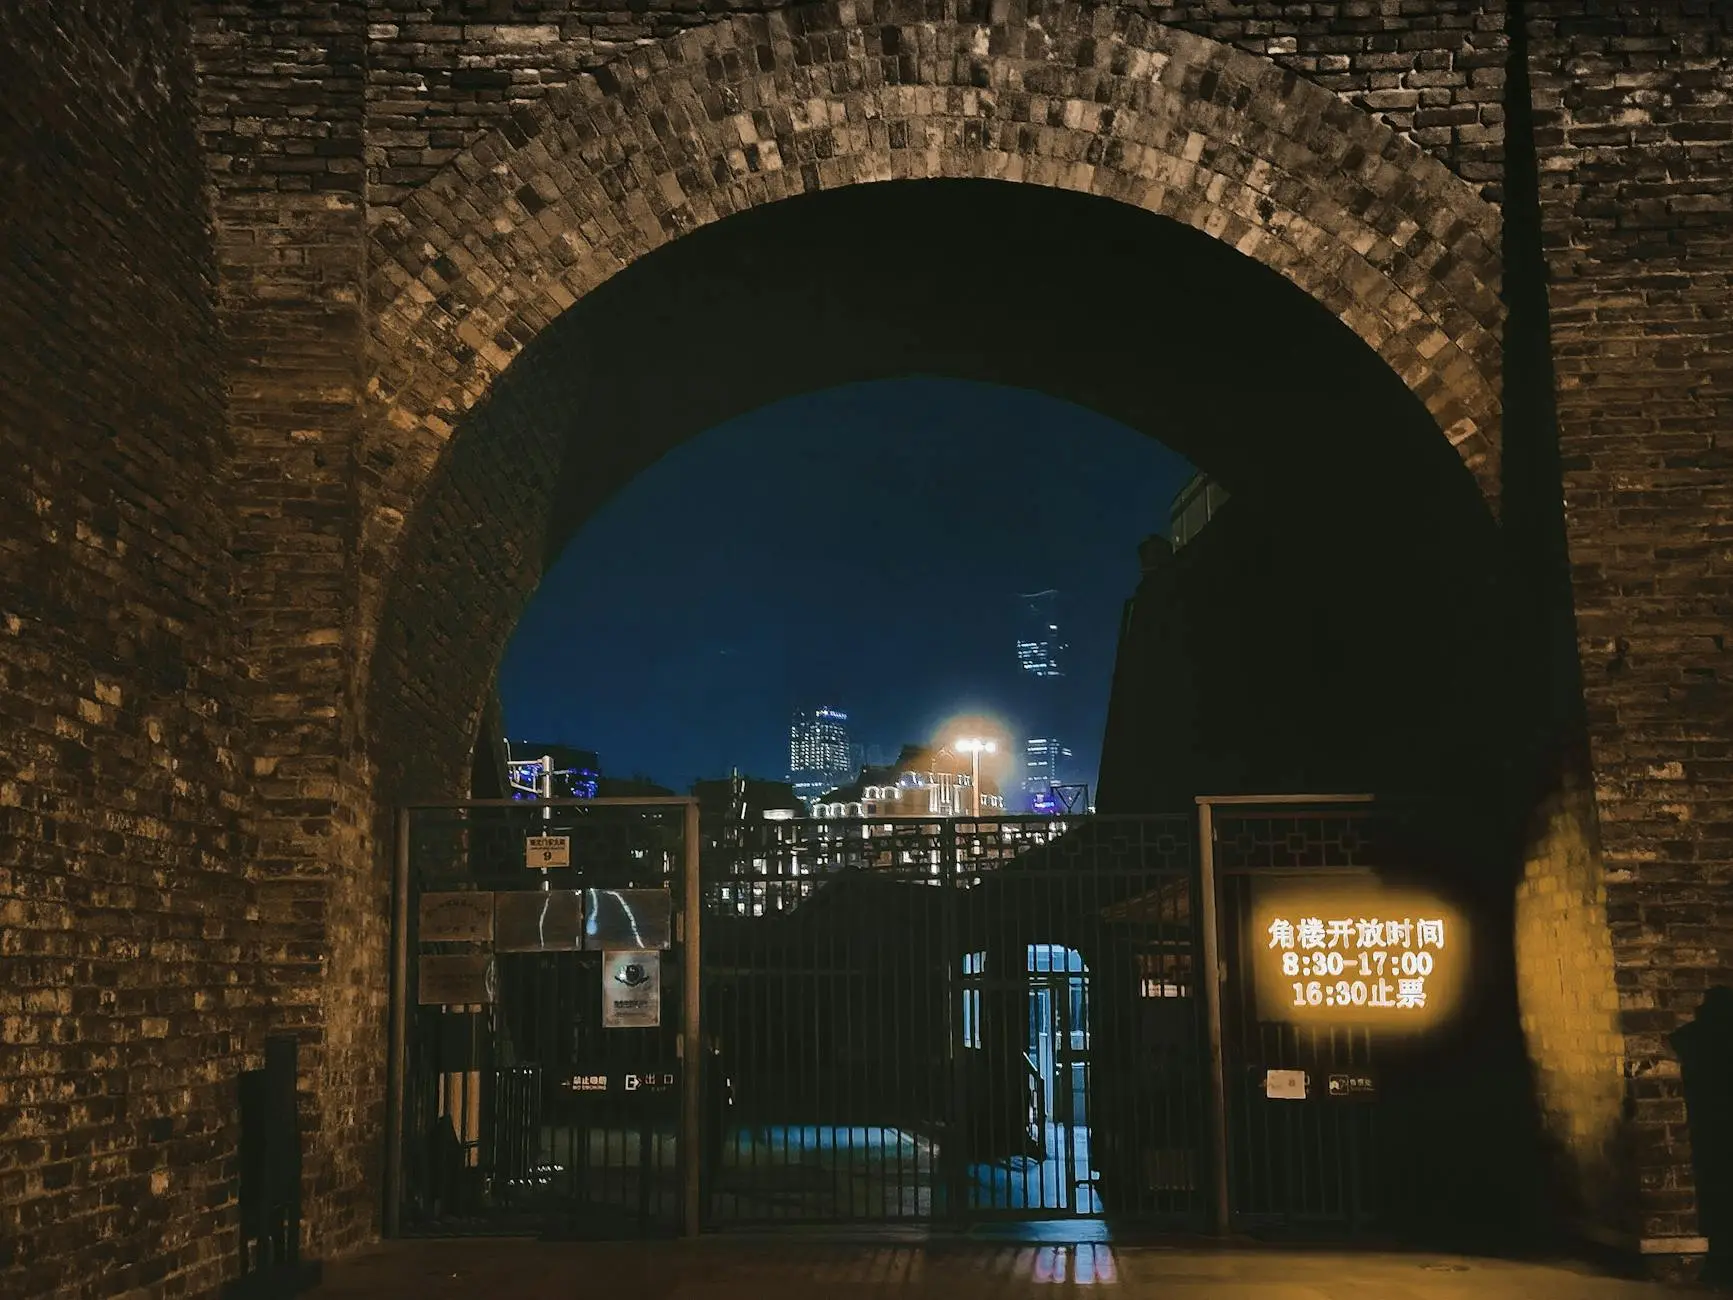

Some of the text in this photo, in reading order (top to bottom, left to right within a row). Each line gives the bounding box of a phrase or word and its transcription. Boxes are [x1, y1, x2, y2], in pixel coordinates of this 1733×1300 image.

[1268, 917, 1445, 949] 角楼开放时间
[1282, 951, 1433, 976] 8:30-17:00
[1292, 977, 1426, 1008] 16:30止票
